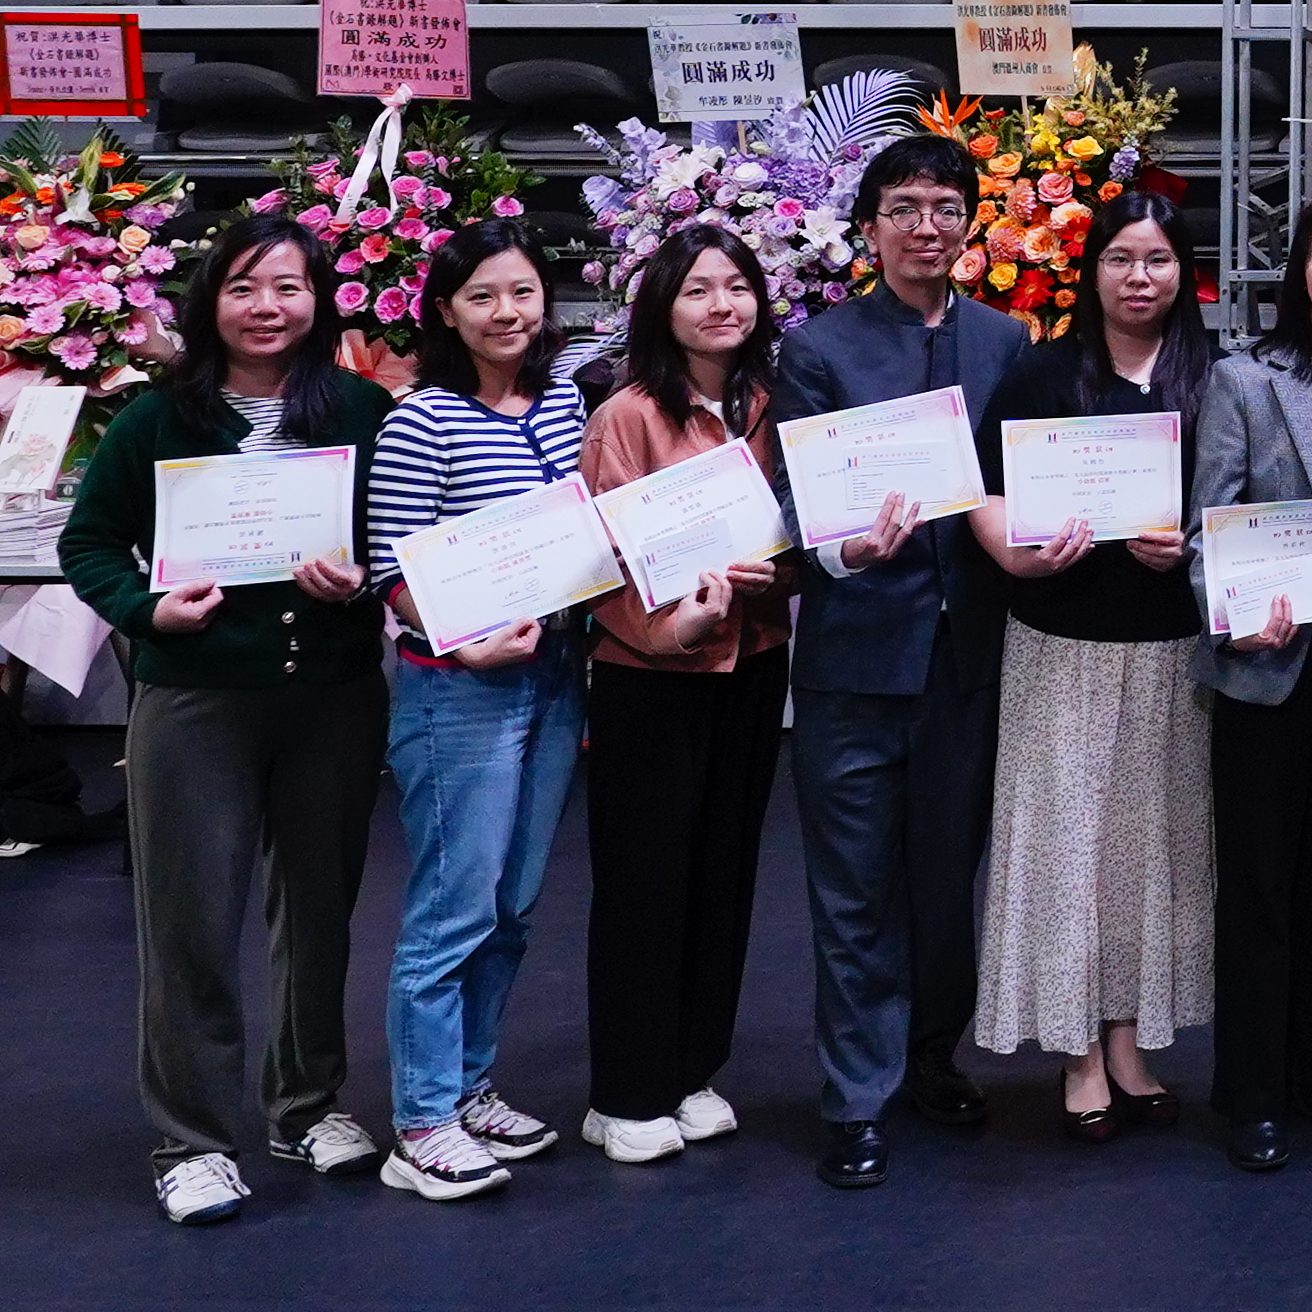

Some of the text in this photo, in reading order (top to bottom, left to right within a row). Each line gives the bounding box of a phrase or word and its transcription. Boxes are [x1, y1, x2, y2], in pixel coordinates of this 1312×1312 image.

[342, 29, 447, 50] 圓滿成功
[979, 26, 1047, 52] 圓滿成功
[682, 60, 775, 84] 圓滿成功
